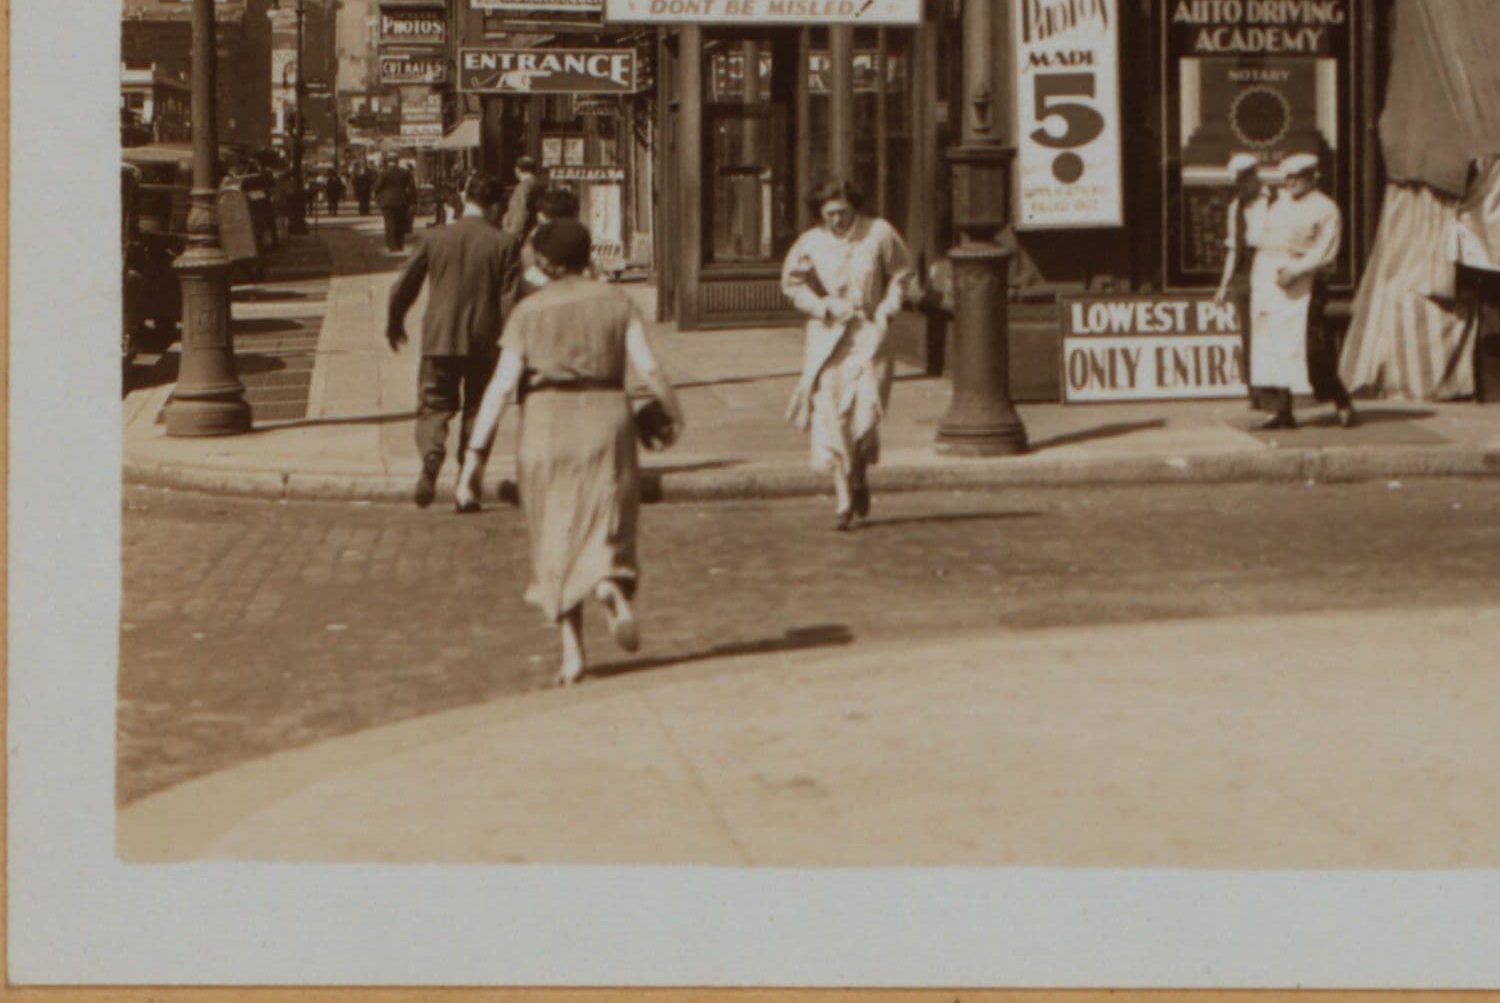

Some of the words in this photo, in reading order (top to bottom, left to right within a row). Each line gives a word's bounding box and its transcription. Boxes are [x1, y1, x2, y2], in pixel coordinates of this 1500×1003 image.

[726, 0, 756, 17] BE
[1247, 0, 1345, 25] DRIVING
[383, 12, 443, 35] PHOTOS
[1194, 28, 1323, 52] ACADEMY
[464, 53, 629, 87] ENTRANCE
[1029, 72, 1105, 149] 5
[1071, 301, 1189, 334] LOWEST
[1197, 301, 1239, 333] PR
[1069, 347, 1142, 391] ONLY
[1155, 346, 1249, 388] ENTRA
